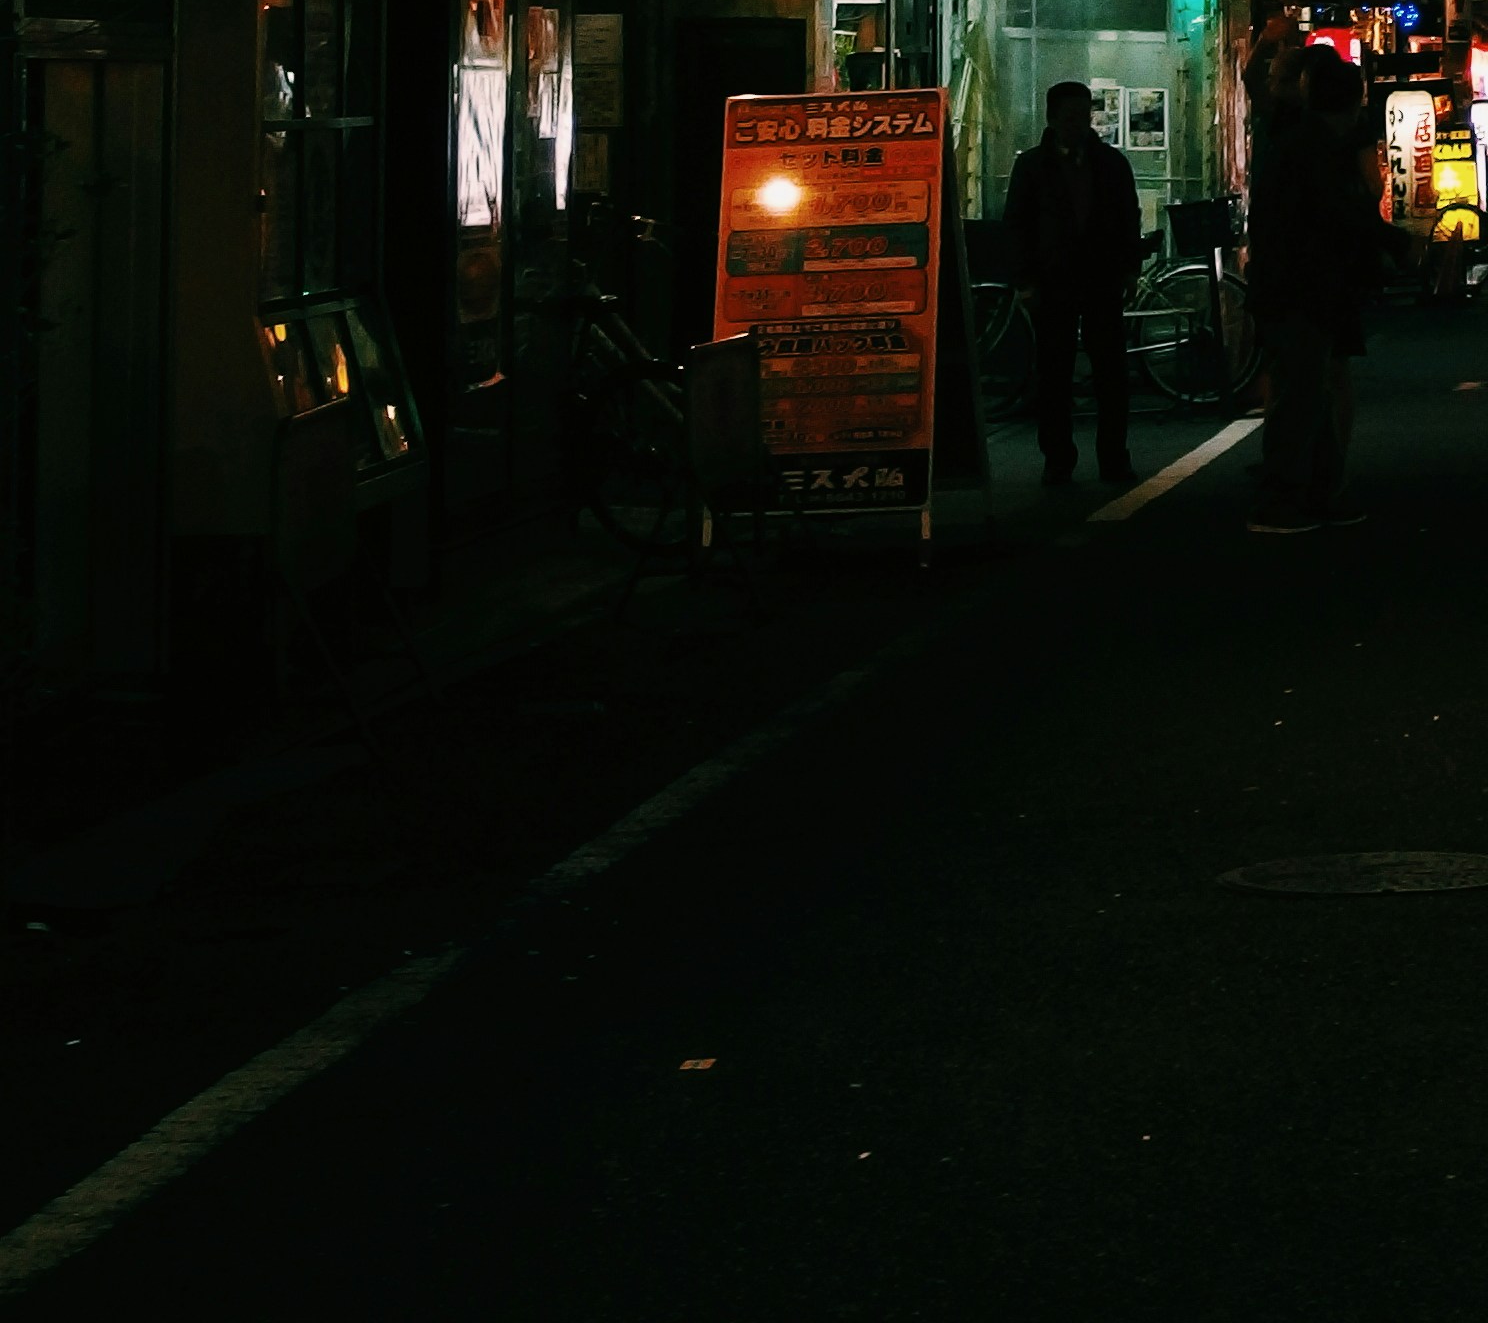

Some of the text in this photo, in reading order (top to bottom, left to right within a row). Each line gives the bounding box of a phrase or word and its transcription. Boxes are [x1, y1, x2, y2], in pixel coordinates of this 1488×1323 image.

[734, 111, 934, 143] ご安心 料金システム
[778, 146, 887, 170] セット料金
[780, 466, 905, 491] ミス大阪
